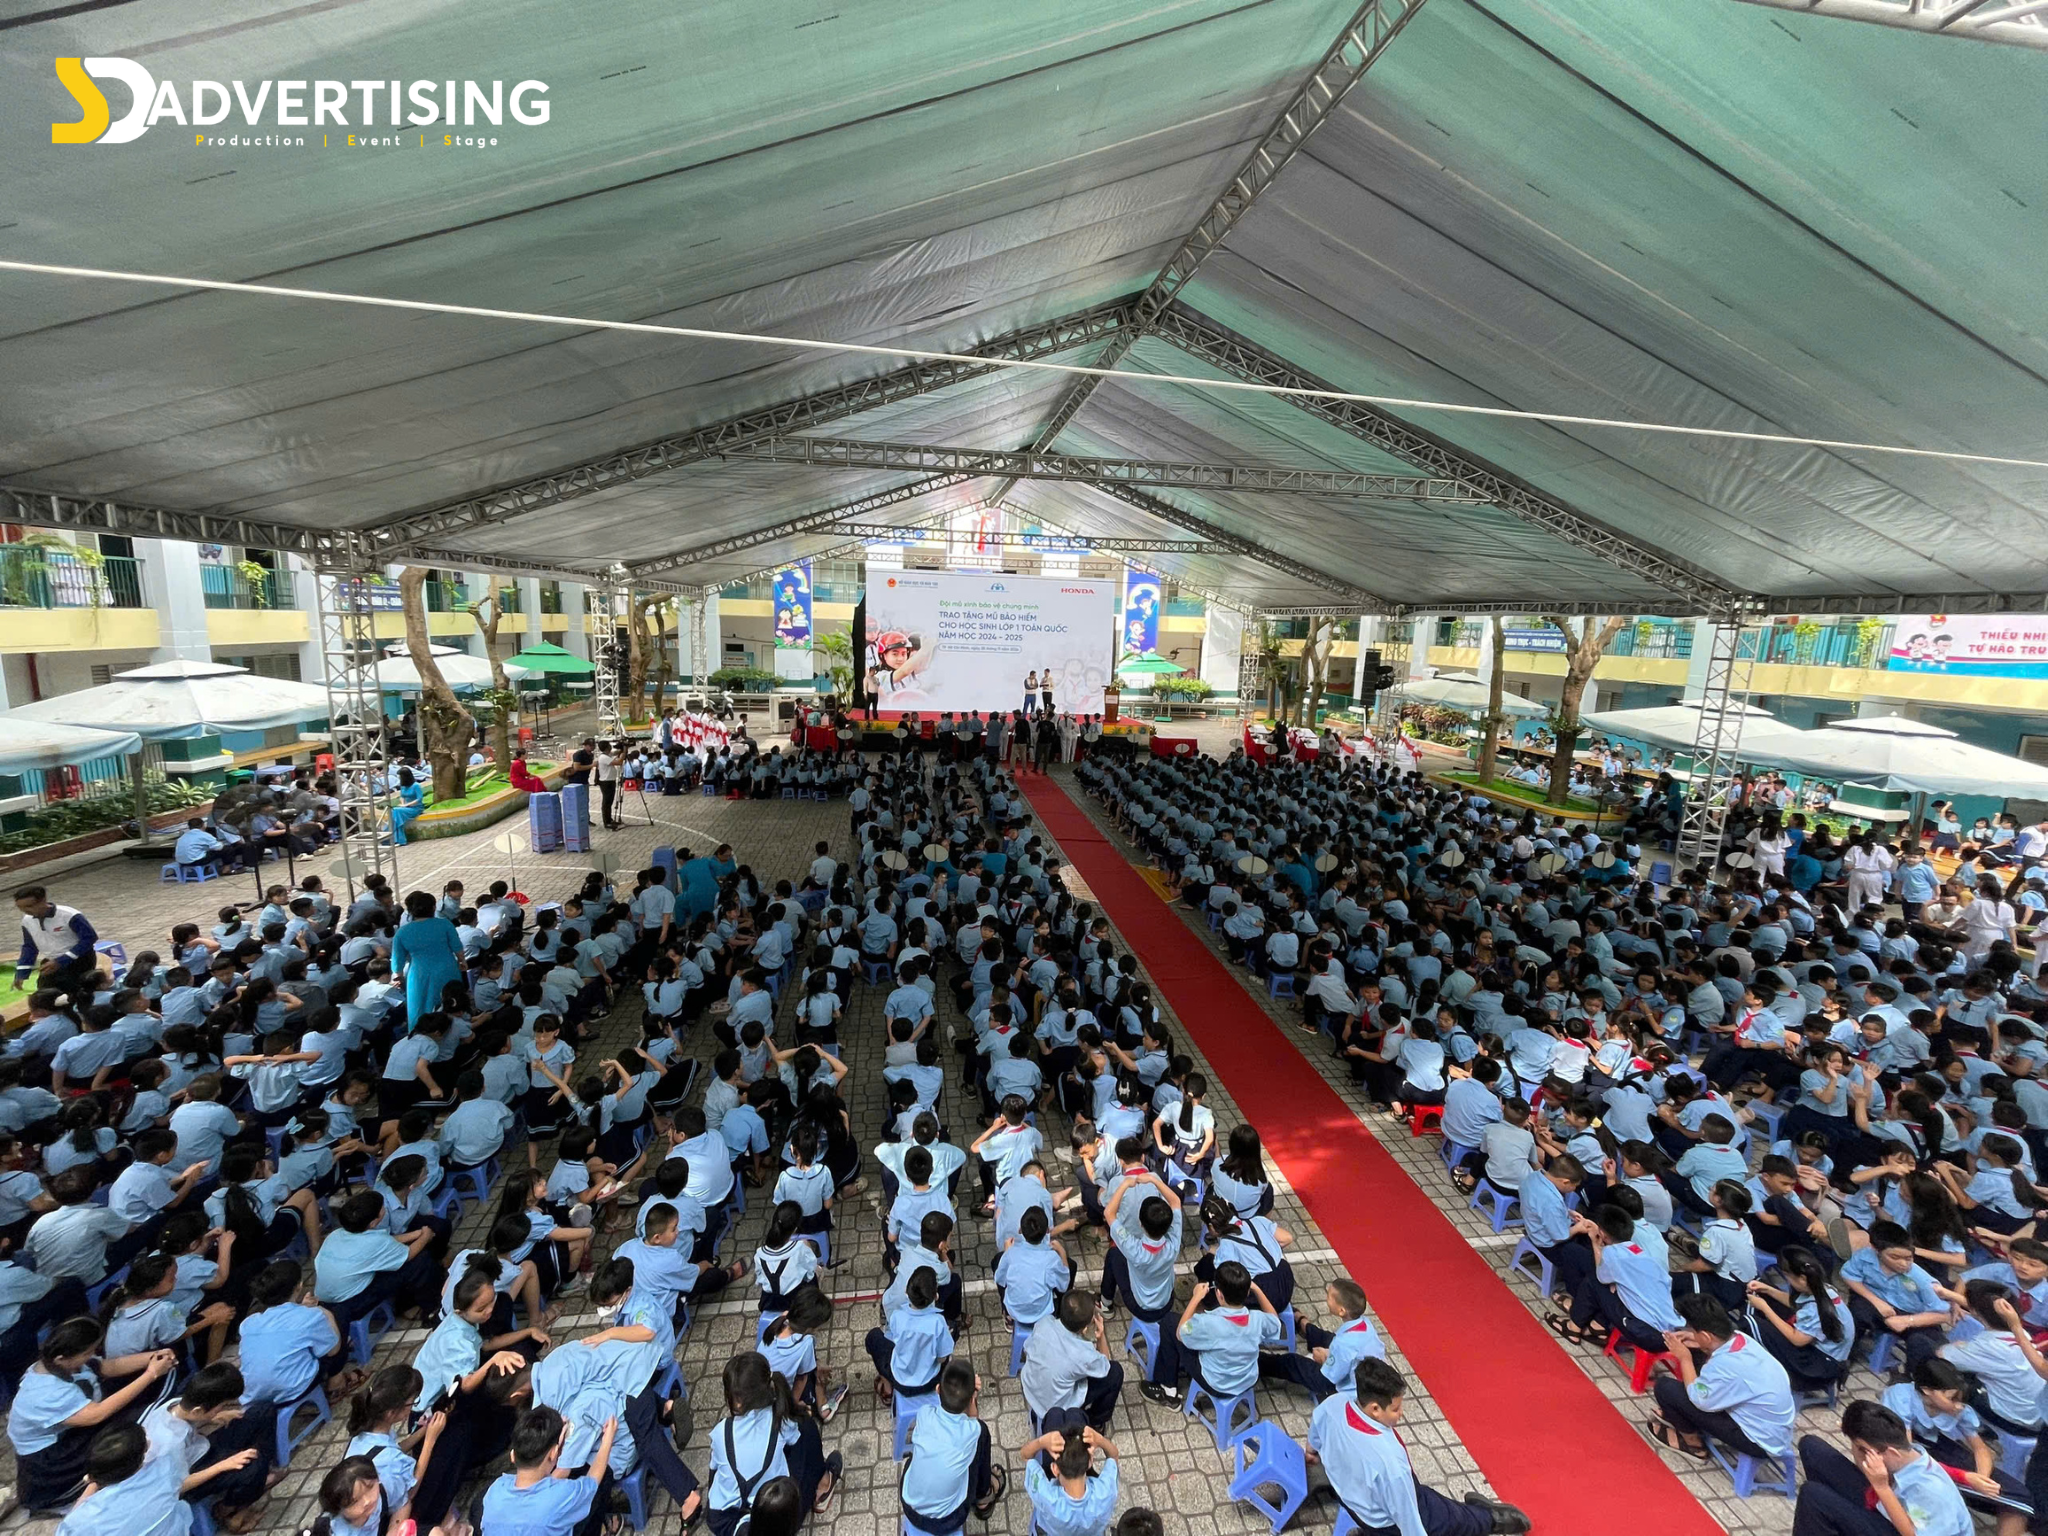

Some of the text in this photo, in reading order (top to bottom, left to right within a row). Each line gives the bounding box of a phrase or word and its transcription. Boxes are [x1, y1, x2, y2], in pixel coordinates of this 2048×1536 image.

[1061, 587, 1095, 595] HONDA
[939, 611, 960, 619] TRAO
[938, 621, 957, 629] CHO
[959, 622, 977, 631] HỌC
[979, 622, 997, 631] SINH
[958, 631, 977, 641] HỌC
[978, 633, 997, 641] 2024
[1005, 634, 1023, 642] 2025
[1980, 627, 2046, 641] THIẾU NHI
[1968, 643, 1986, 656] TỰ
[1989, 643, 2014, 654] HÀO
